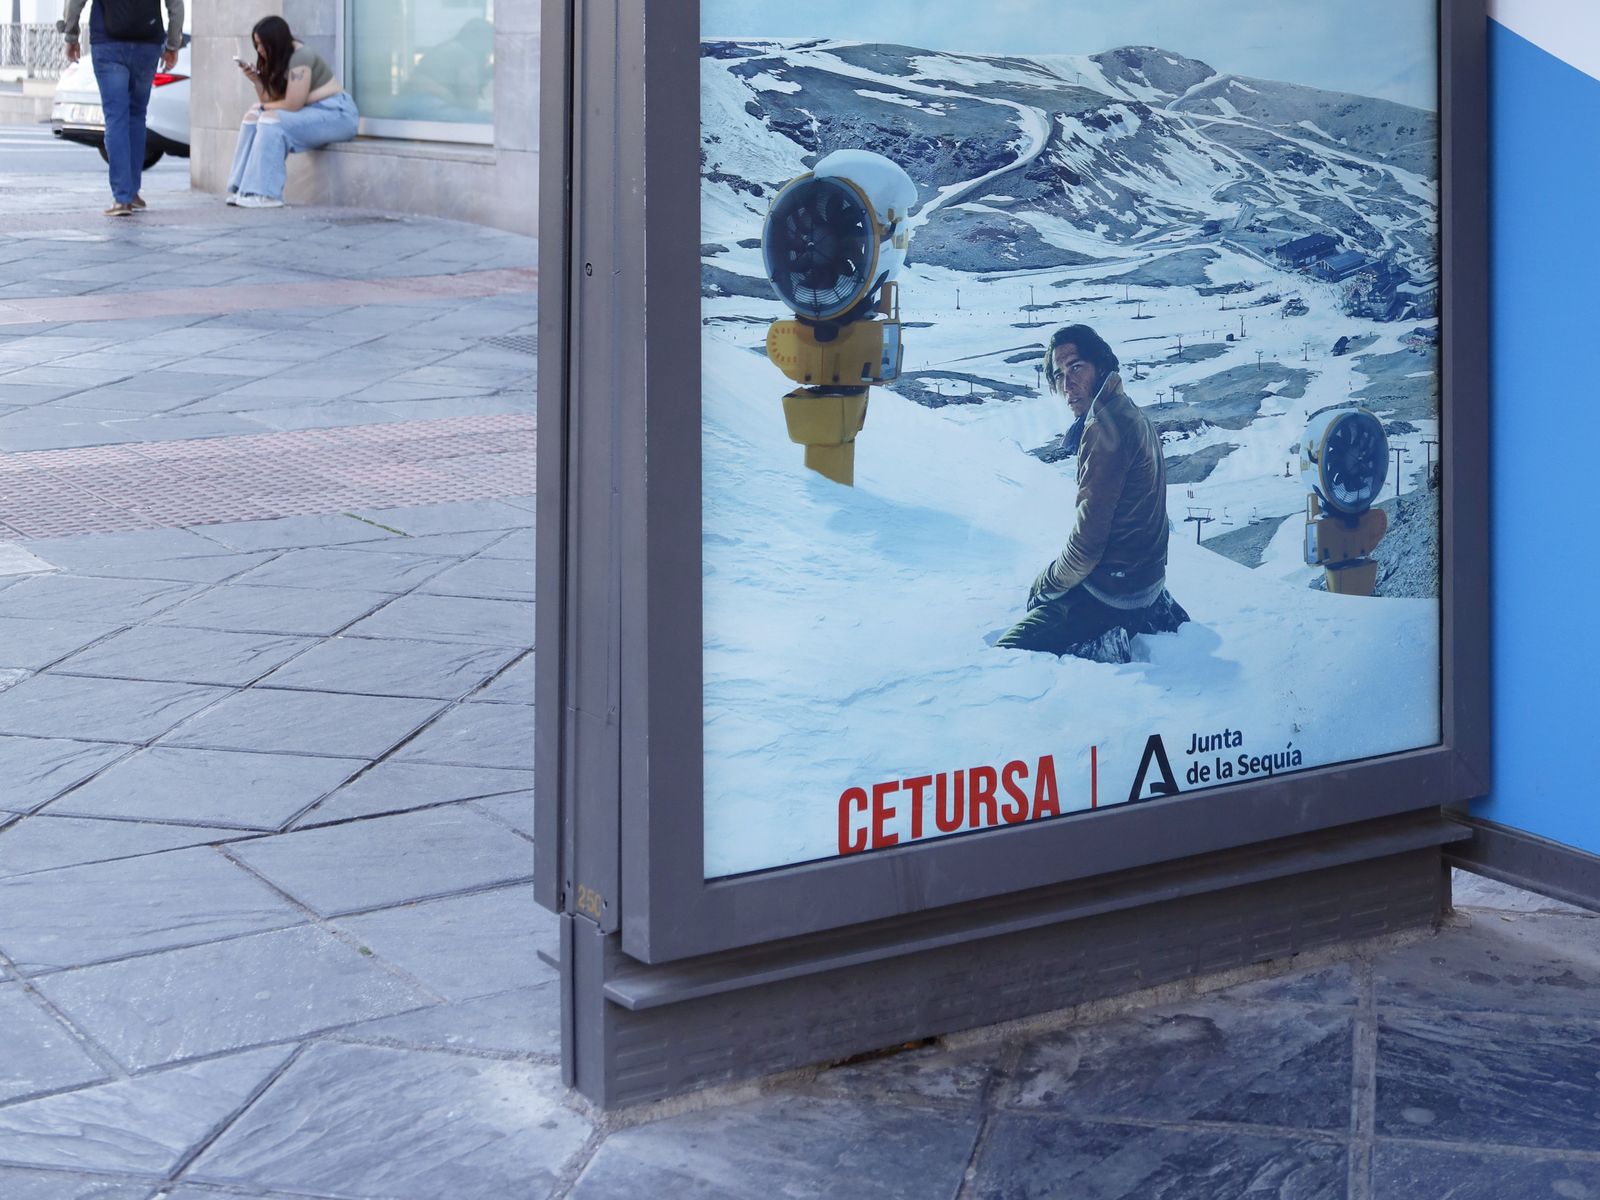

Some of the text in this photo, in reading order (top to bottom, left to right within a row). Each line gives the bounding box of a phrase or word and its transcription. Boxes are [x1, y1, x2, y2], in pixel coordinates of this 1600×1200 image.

[1186, 728, 1243, 755] Junta
[1186, 741, 1302, 785] de la Sequía
[838, 754, 1061, 856] CETURSA
